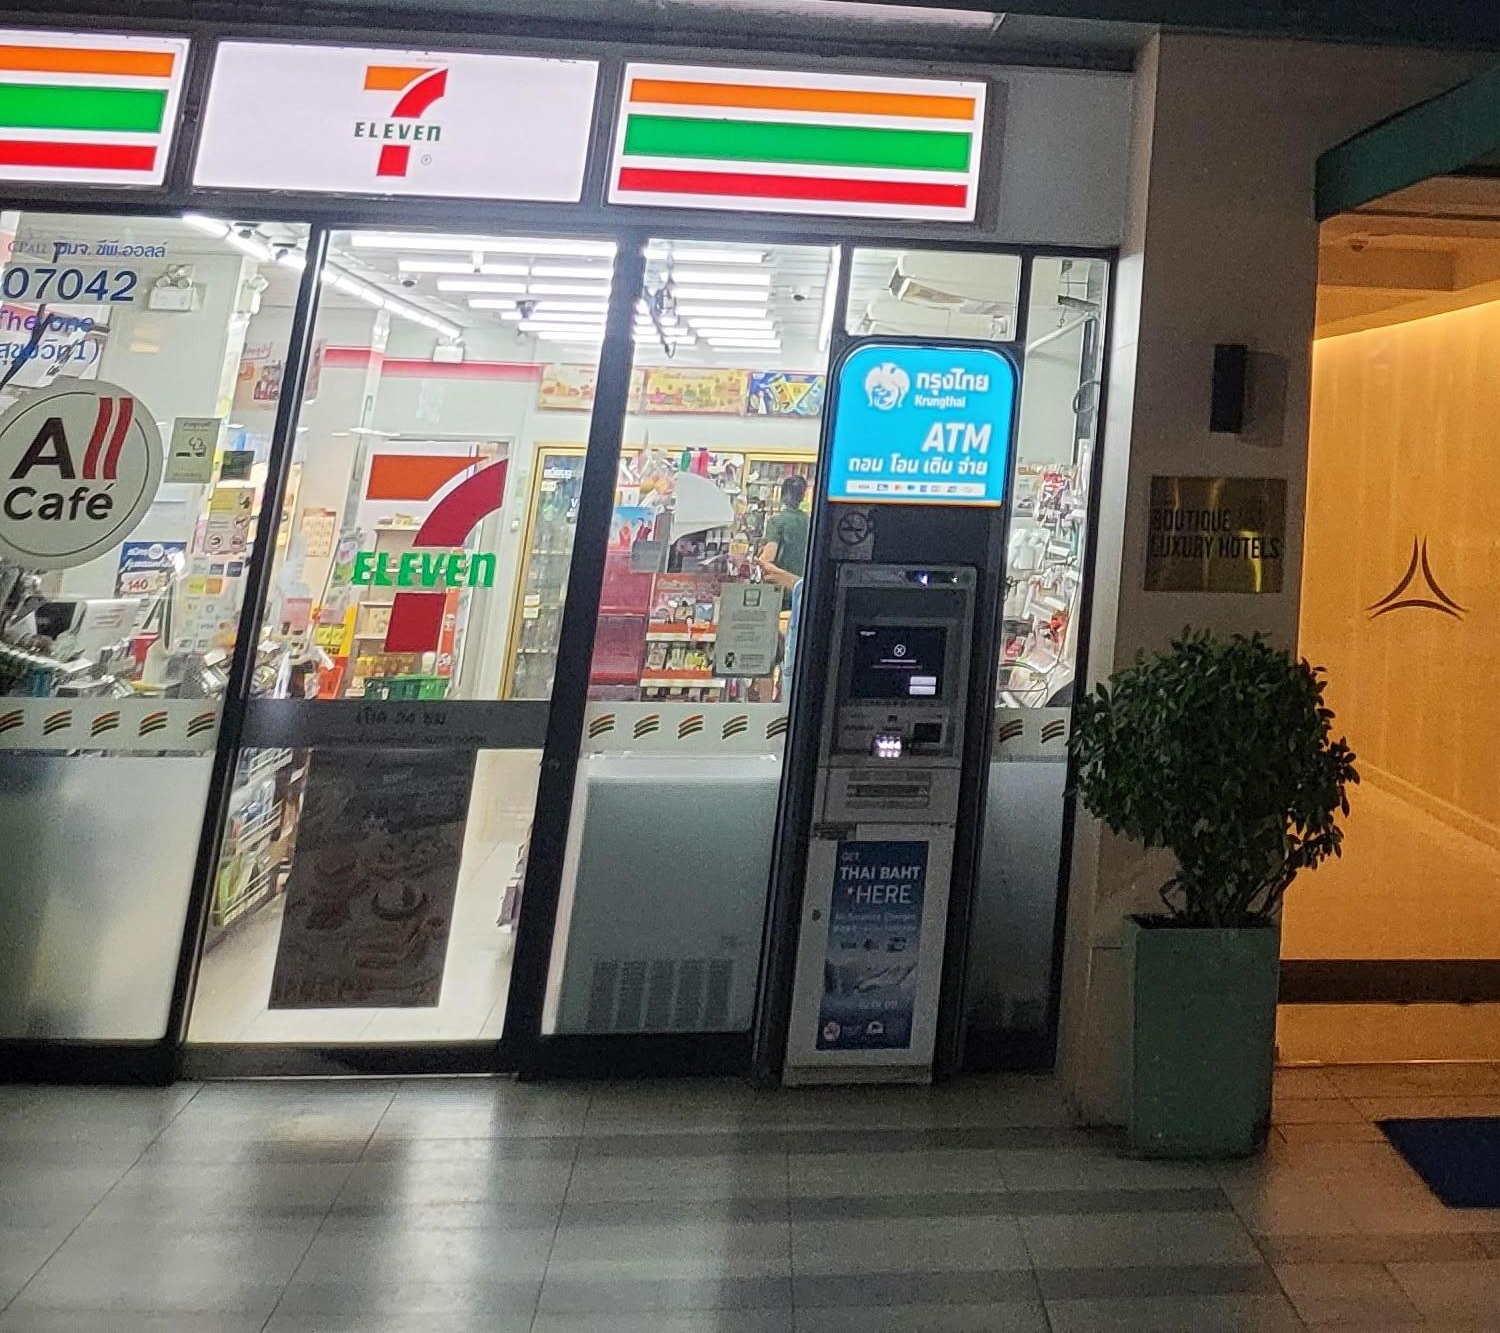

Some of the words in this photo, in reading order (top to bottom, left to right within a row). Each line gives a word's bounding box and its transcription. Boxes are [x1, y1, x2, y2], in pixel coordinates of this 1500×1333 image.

[2, 267, 138, 302] 07042
[916, 367, 990, 396] กรุงไทย
[914, 394, 967, 410] Krungthai
[10, 397, 134, 480] All
[920, 422, 993, 454] ATM
[848, 456, 884, 473] ถอน
[889, 452, 919, 474] โอน
[923, 456, 953, 475] เติม
[957, 456, 989, 476] จ่าย
[3, 483, 114, 521] Café
[1218, 536, 1282, 560] HOTELS
[839, 866, 876, 880] THAI
[879, 866, 921, 880] BAHT
[856, 884, 913, 904] HERE
